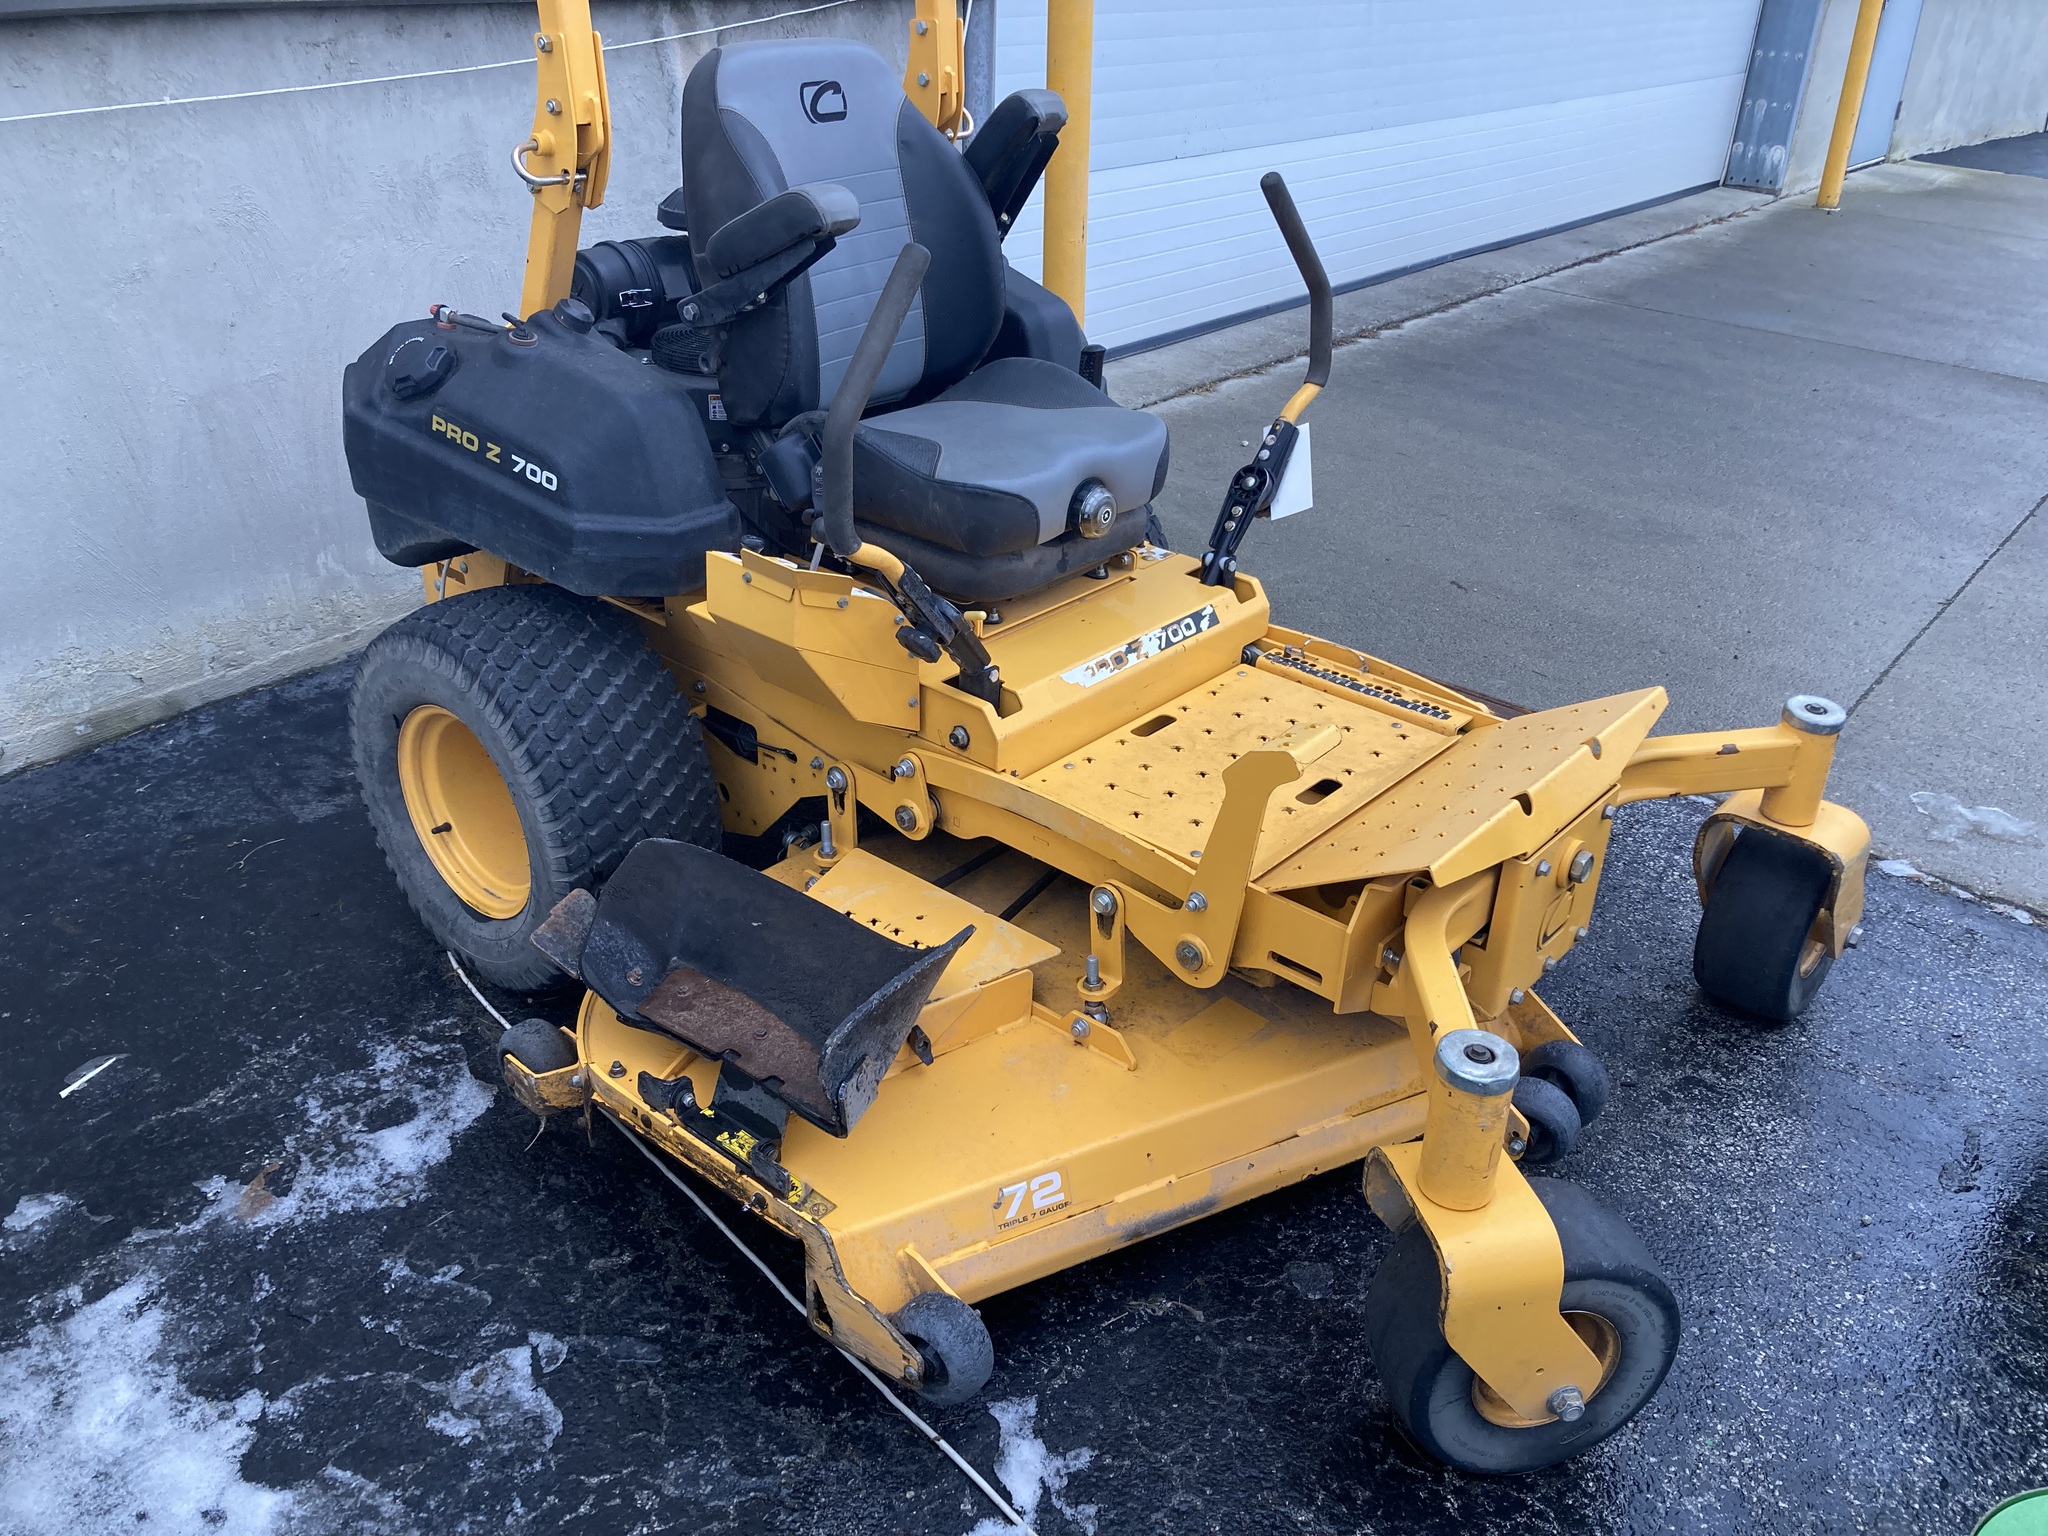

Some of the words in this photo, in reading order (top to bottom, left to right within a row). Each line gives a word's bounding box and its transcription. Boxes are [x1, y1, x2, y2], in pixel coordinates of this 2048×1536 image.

[432, 414, 478, 452] PRO
[485, 442, 501, 464] Z
[511, 454, 558, 491] 700
[1156, 617, 1197, 650] 700
[998, 1171, 1065, 1220] 72
[998, 1215, 1029, 1230] TRIPLE
